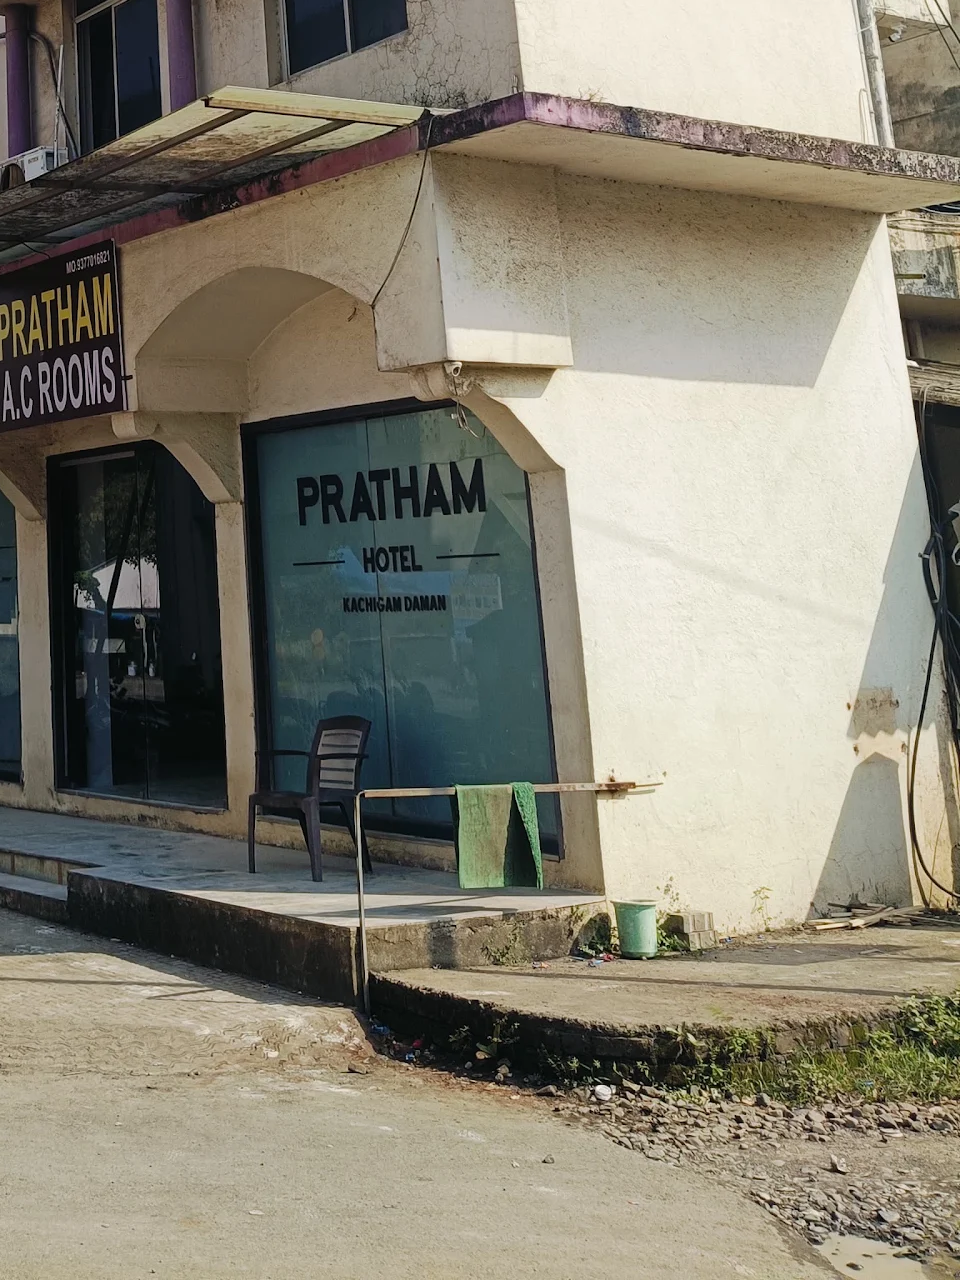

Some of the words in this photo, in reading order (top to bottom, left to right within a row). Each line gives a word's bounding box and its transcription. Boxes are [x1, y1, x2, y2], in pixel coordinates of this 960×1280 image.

[66, 250, 110, 274] MO.9377016821
[2, 365, 34, 422] A.C
[38, 346, 116, 415] ROOMS
[297, 458, 487, 526] PRATHAM
[362, 545, 423, 573] HOTEL
[343, 595, 402, 613] KACHIGAM
[404, 594, 447, 611] DAMAN
